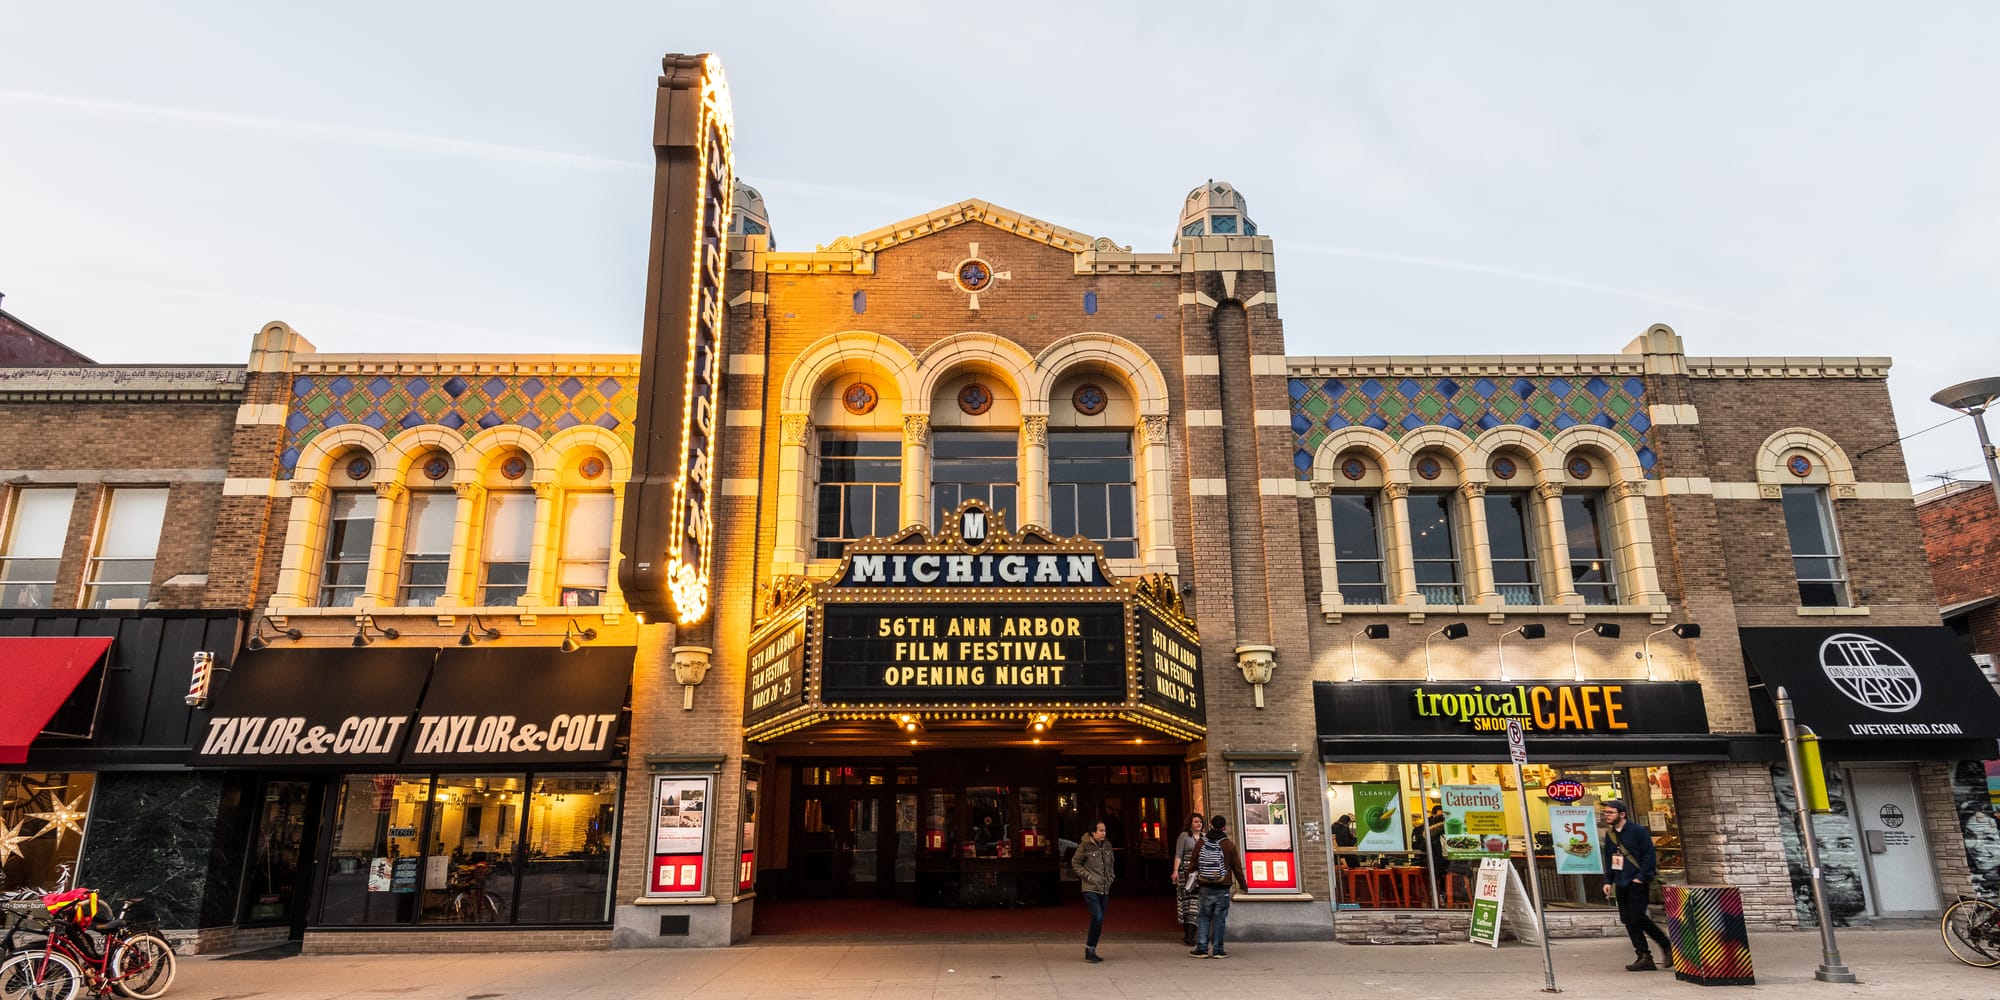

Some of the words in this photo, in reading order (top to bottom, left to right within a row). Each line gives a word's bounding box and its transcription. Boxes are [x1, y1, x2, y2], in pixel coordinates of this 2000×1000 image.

[688, 140, 728, 546] MICHIGAN
[963, 513, 984, 539] M
[852, 555, 1095, 582] MICHIGAN
[879, 618, 935, 637] 56TH
[947, 618, 991, 637] ANN
[1003, 617, 1081, 637] ARBOR
[752, 650, 765, 672] 56TH
[765, 642, 776, 664] ANN
[776, 630, 795, 656] ARBOR
[895, 642, 948, 661] FILM
[960, 642, 1066, 661] FESTIVAL
[1152, 627, 1167, 652] 56TH
[1167, 638, 1179, 660] ANN
[1180, 646, 1197, 671] ARBOR
[1830, 641, 1881, 667] THE
[752, 670, 764, 691] FILM
[765, 655, 789, 684] FESTIVAL
[885, 666, 985, 686] OPENING
[996, 666, 1064, 685] NIGHT
[1155, 651, 1169, 675] FILM
[1170, 660, 1194, 688] FESTIVAL
[1828, 667, 1845, 677] ON
[1847, 667, 1880, 677] SOUTH
[1882, 667, 1911, 677] MAIN
[752, 687, 770, 710] MARCH
[770, 683, 778, 702] 20
[784, 676, 791, 695] 25
[1156, 674, 1177, 700] MARCH
[1177, 685, 1185, 703] 20
[1190, 691, 1196, 709] 25
[1844, 678, 1914, 705] YARD
[1415, 685, 1531, 722] tropical
[1530, 686, 1628, 730] CAFE
[1474, 717, 1533, 731] SMOOIE
[1849, 724, 1963, 735] LIVETHEYARD.COM
[1446, 791, 1500, 810] Catering
[1548, 785, 1582, 797] OPEN
[1564, 823, 1588, 843] $5
[1483, 884, 1497, 897] CAFE
